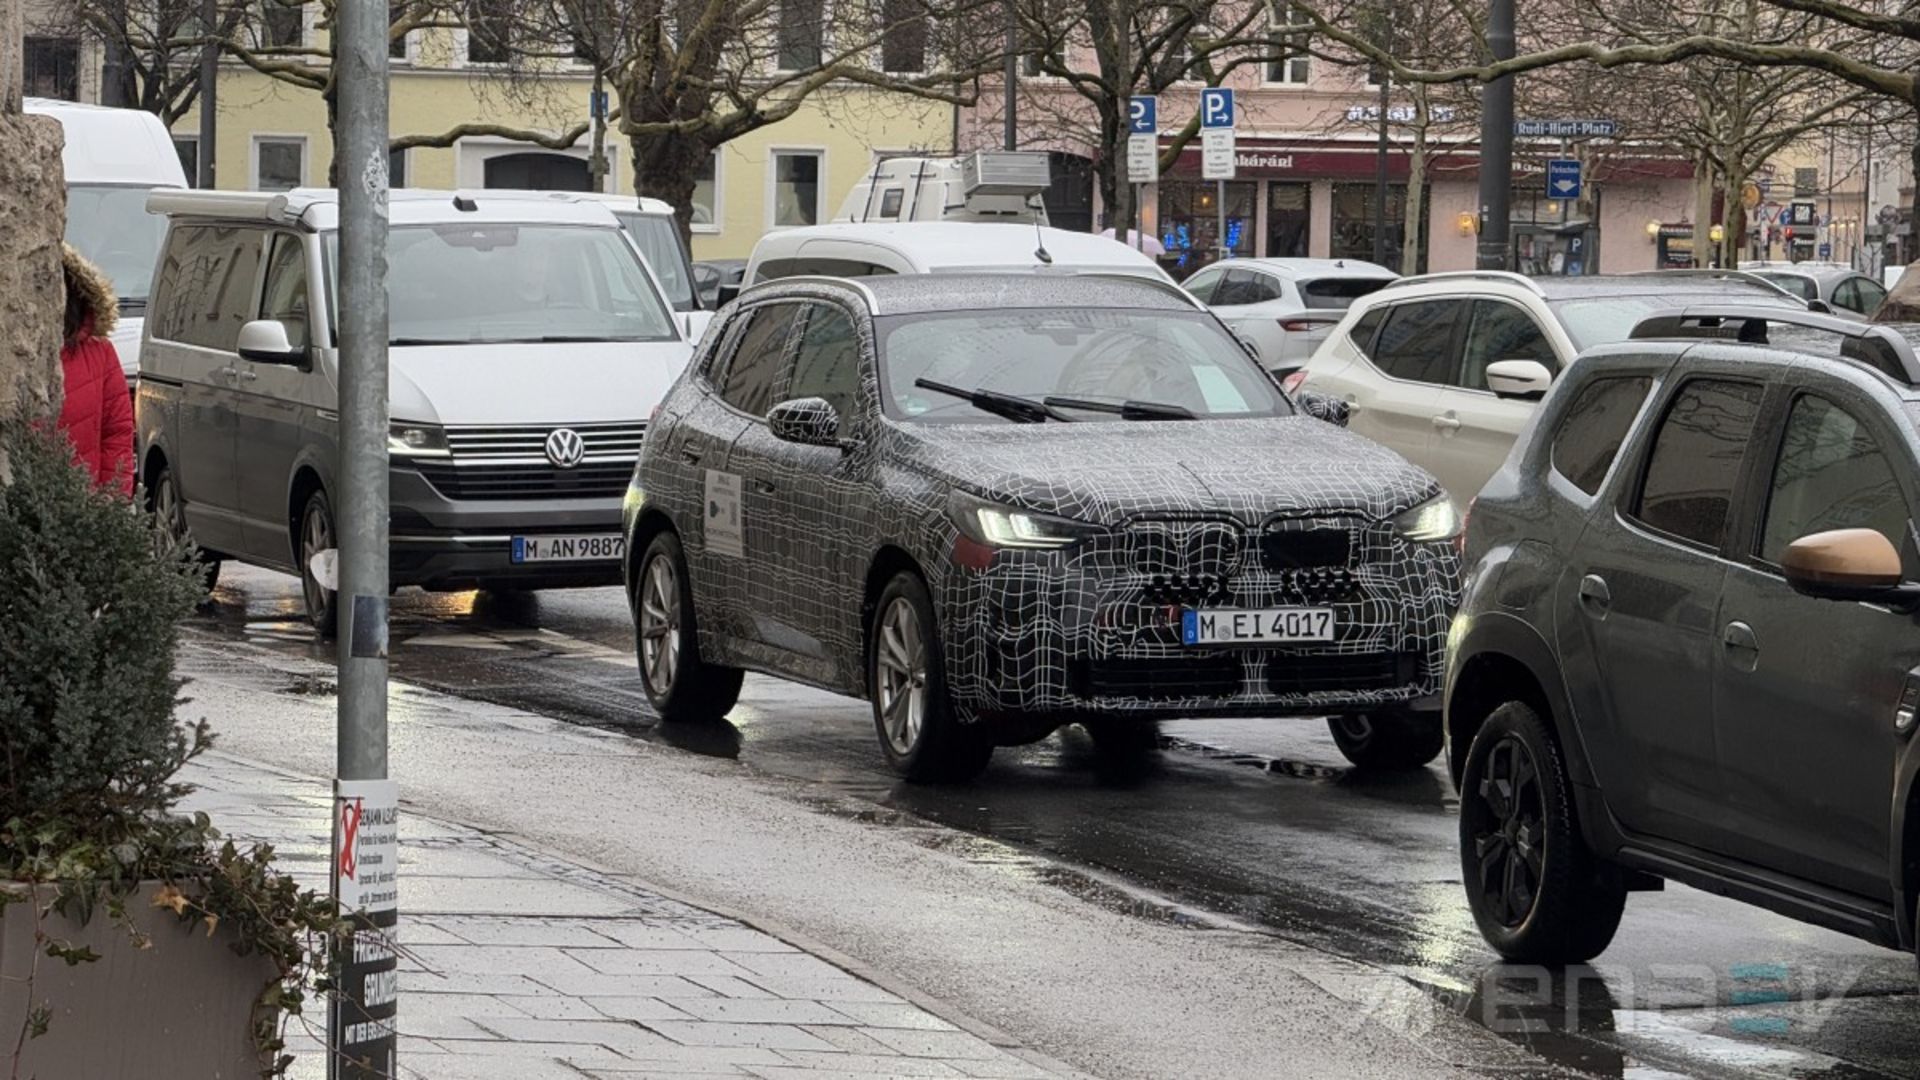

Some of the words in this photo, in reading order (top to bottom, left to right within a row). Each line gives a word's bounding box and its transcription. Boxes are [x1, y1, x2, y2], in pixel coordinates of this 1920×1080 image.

[1517, 122, 1612, 136] Rudi-Hierl-Platz
[526, 540, 537, 559] M
[550, 539, 574, 558] AN
[578, 537, 624, 557] 9887
[1200, 614, 1216, 639] M
[1233, 614, 1264, 639] EI
[1271, 612, 1330, 637] 4017
